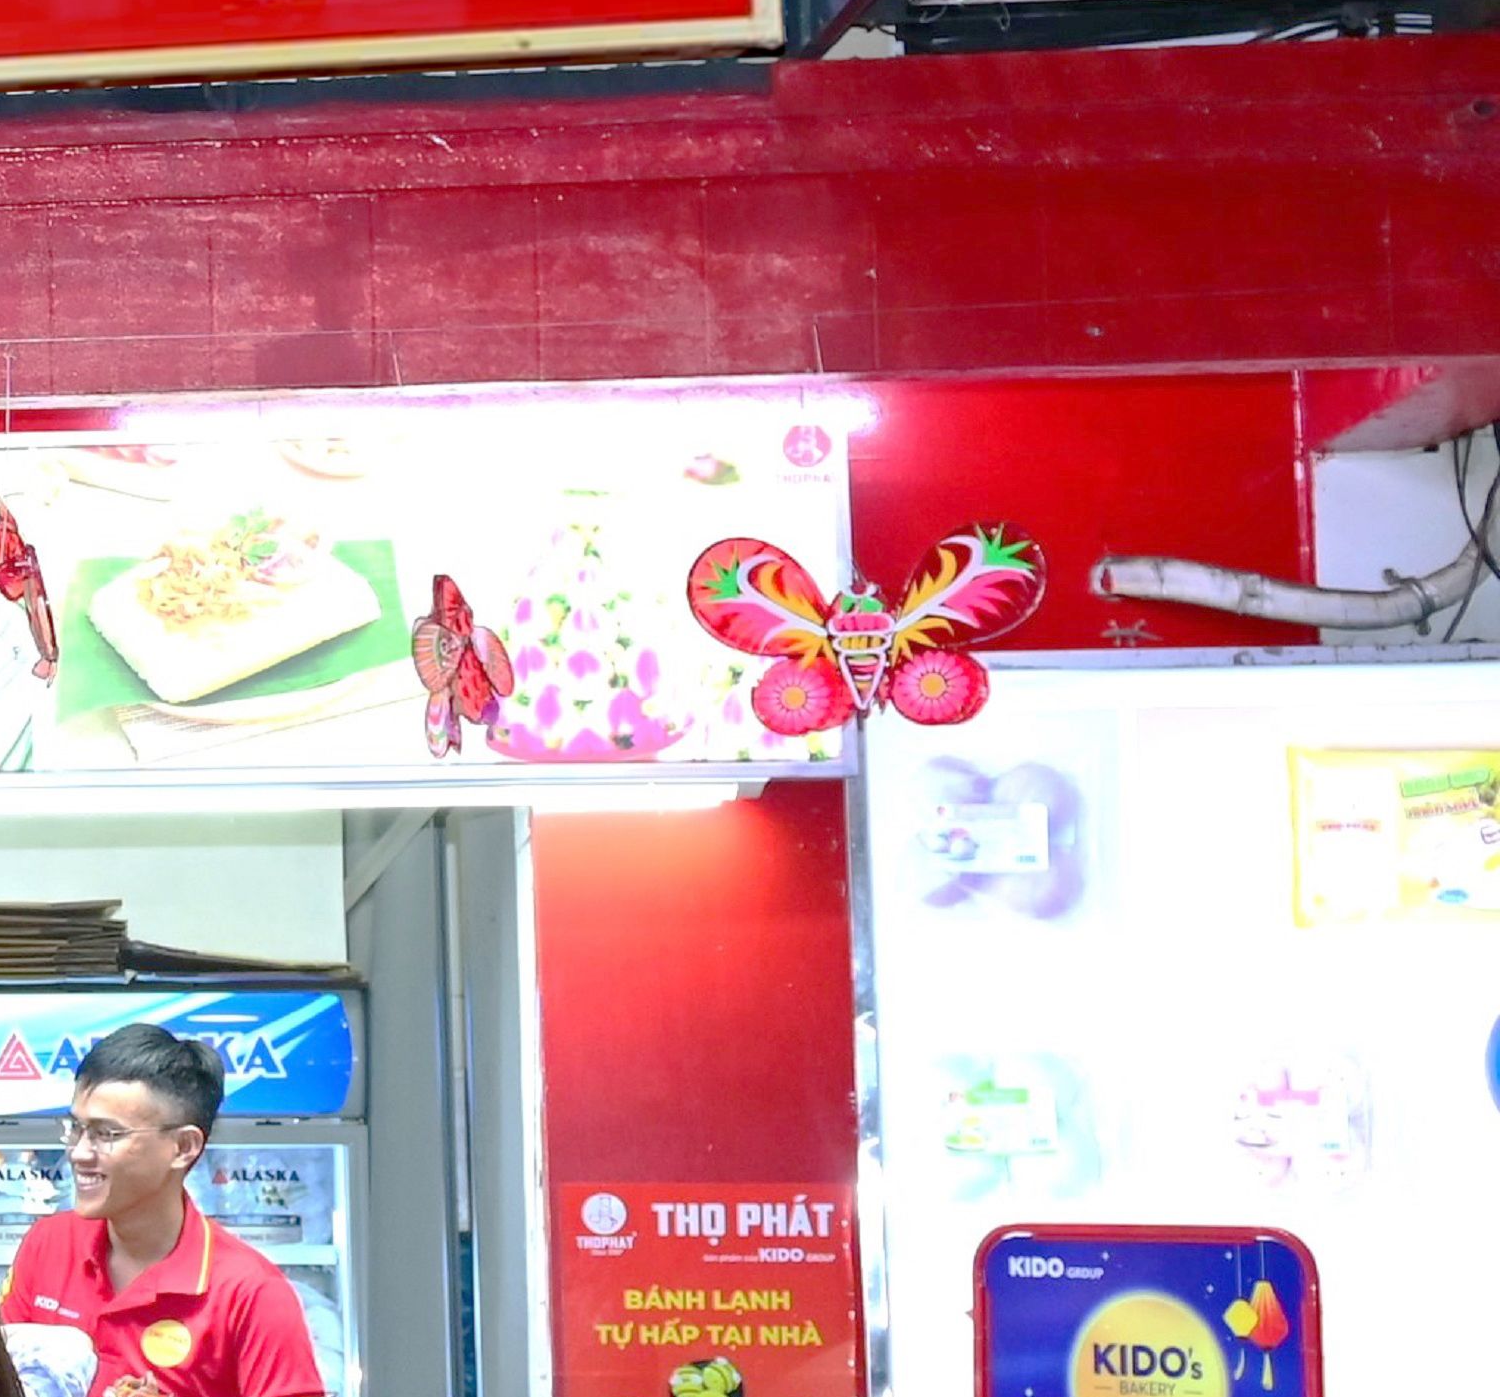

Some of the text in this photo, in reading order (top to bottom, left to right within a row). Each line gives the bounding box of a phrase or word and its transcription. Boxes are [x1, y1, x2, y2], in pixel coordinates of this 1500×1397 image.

[230, 1169, 300, 1183] ALASKA
[652, 1193, 835, 1247] THỌ PHÁT
[1008, 1256, 1103, 1279] KIDO GROUP
[624, 1284, 792, 1315] BÁNH LẠNH
[595, 1319, 824, 1350] TỰ HẤP TẠI NHÀ
[1093, 1343, 1203, 1381] KIDO's
[1119, 1381, 1175, 1397] BAKERY
